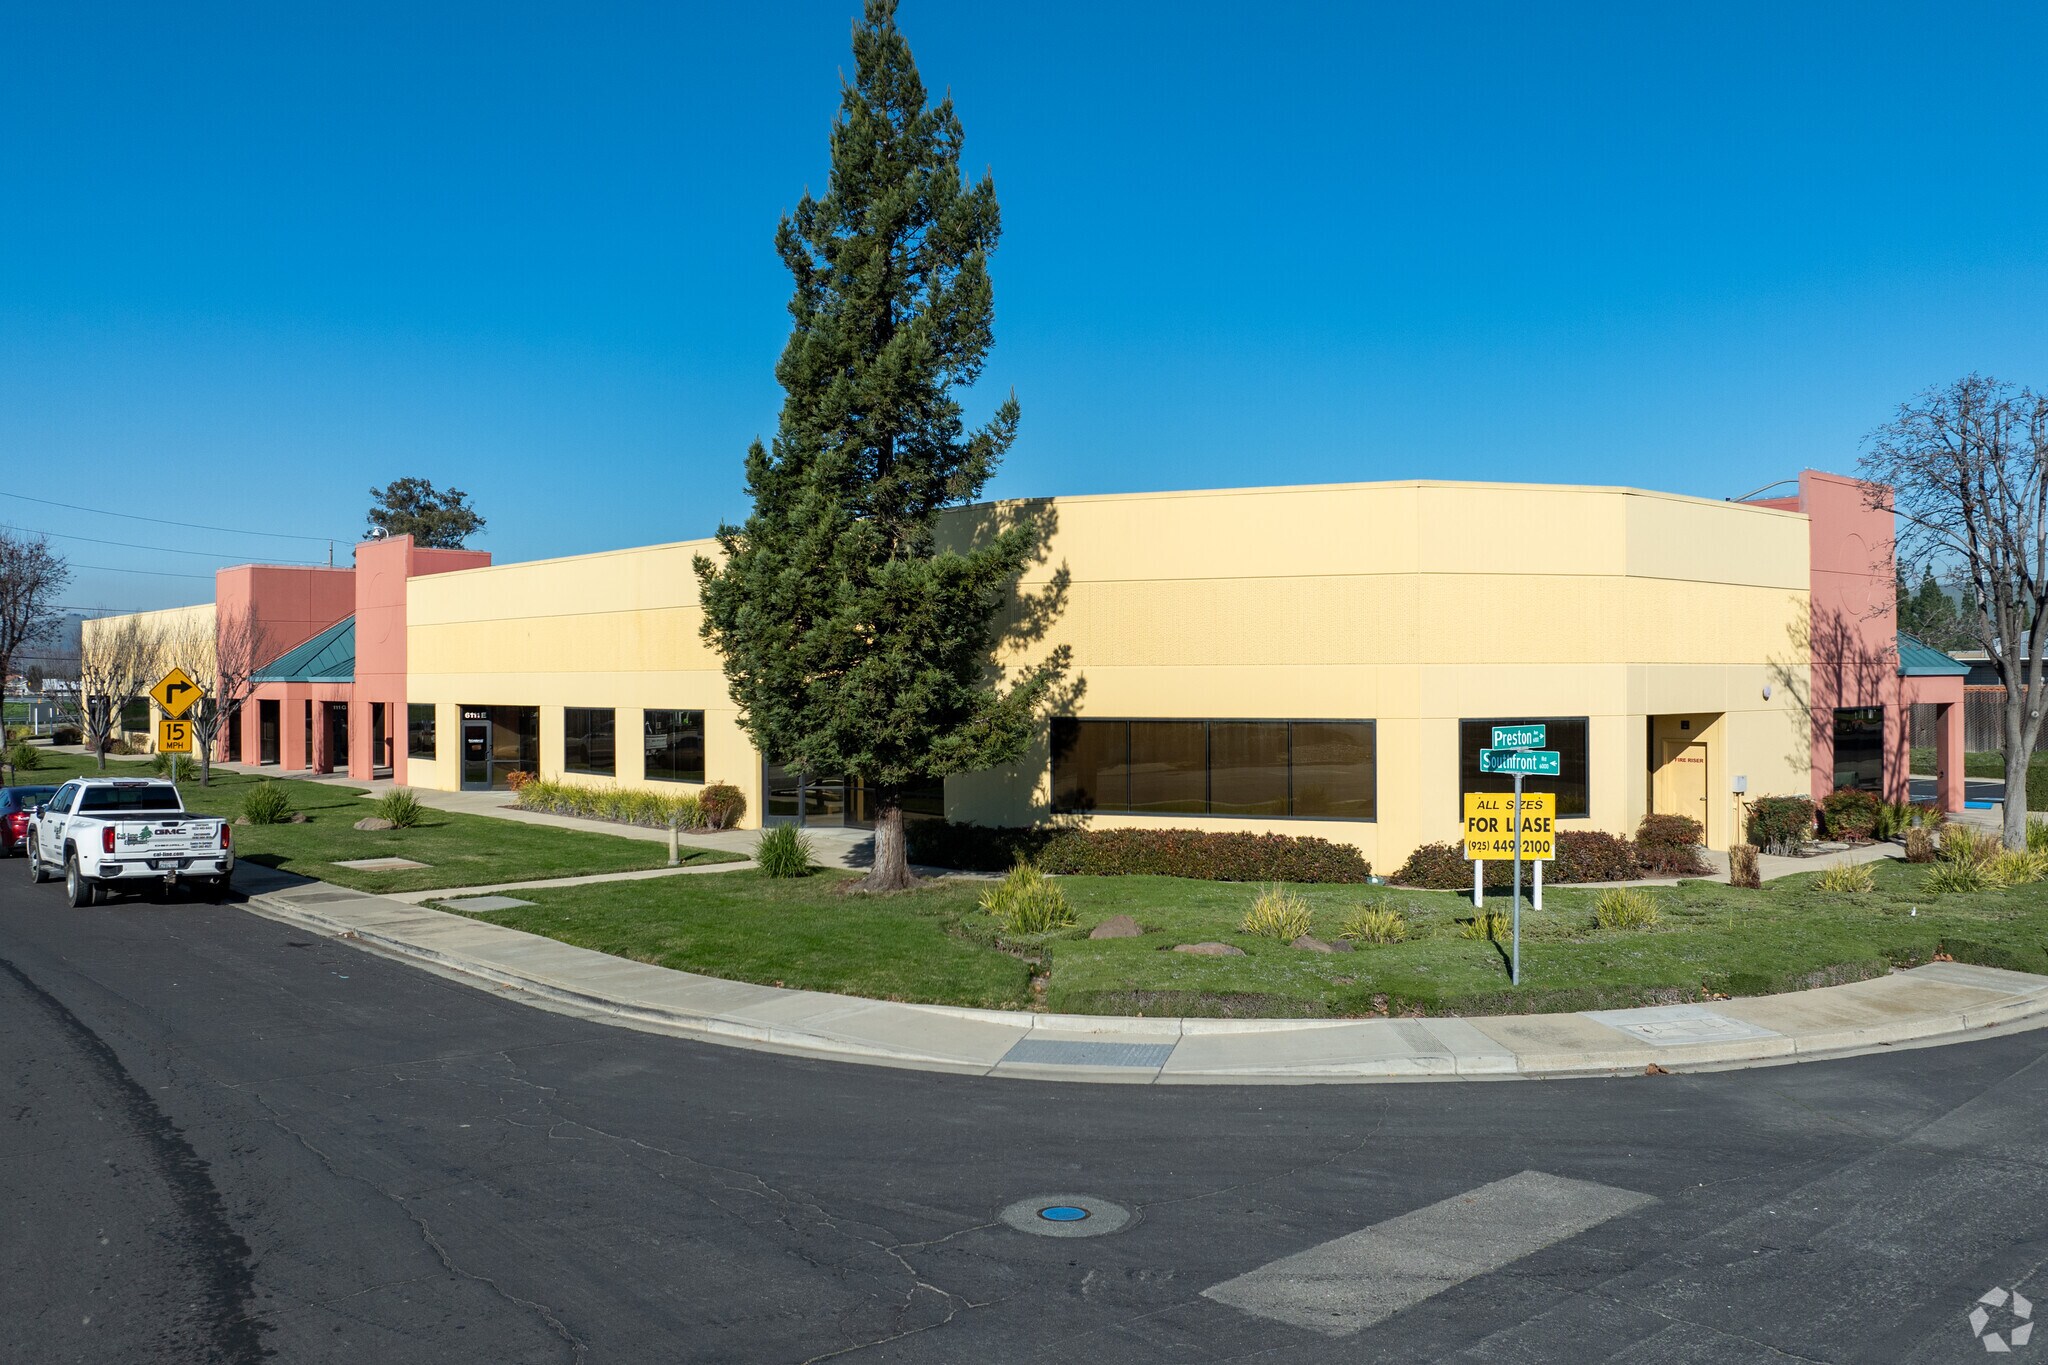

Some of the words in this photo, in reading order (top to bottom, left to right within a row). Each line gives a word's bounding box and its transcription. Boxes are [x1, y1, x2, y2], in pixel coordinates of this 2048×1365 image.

[166, 723, 185, 741] 15
[1494, 730, 1532, 747] Preston
[1483, 752, 1537, 770] Southfront
[1477, 800, 1500, 810] ALL
[1505, 800, 1543, 810] SZES
[1468, 817, 1499, 833] FOR
[1506, 817, 1551, 833] LASE
[1468, 840, 1490, 851] (925)
[1493, 840, 1550, 853] 4492100
